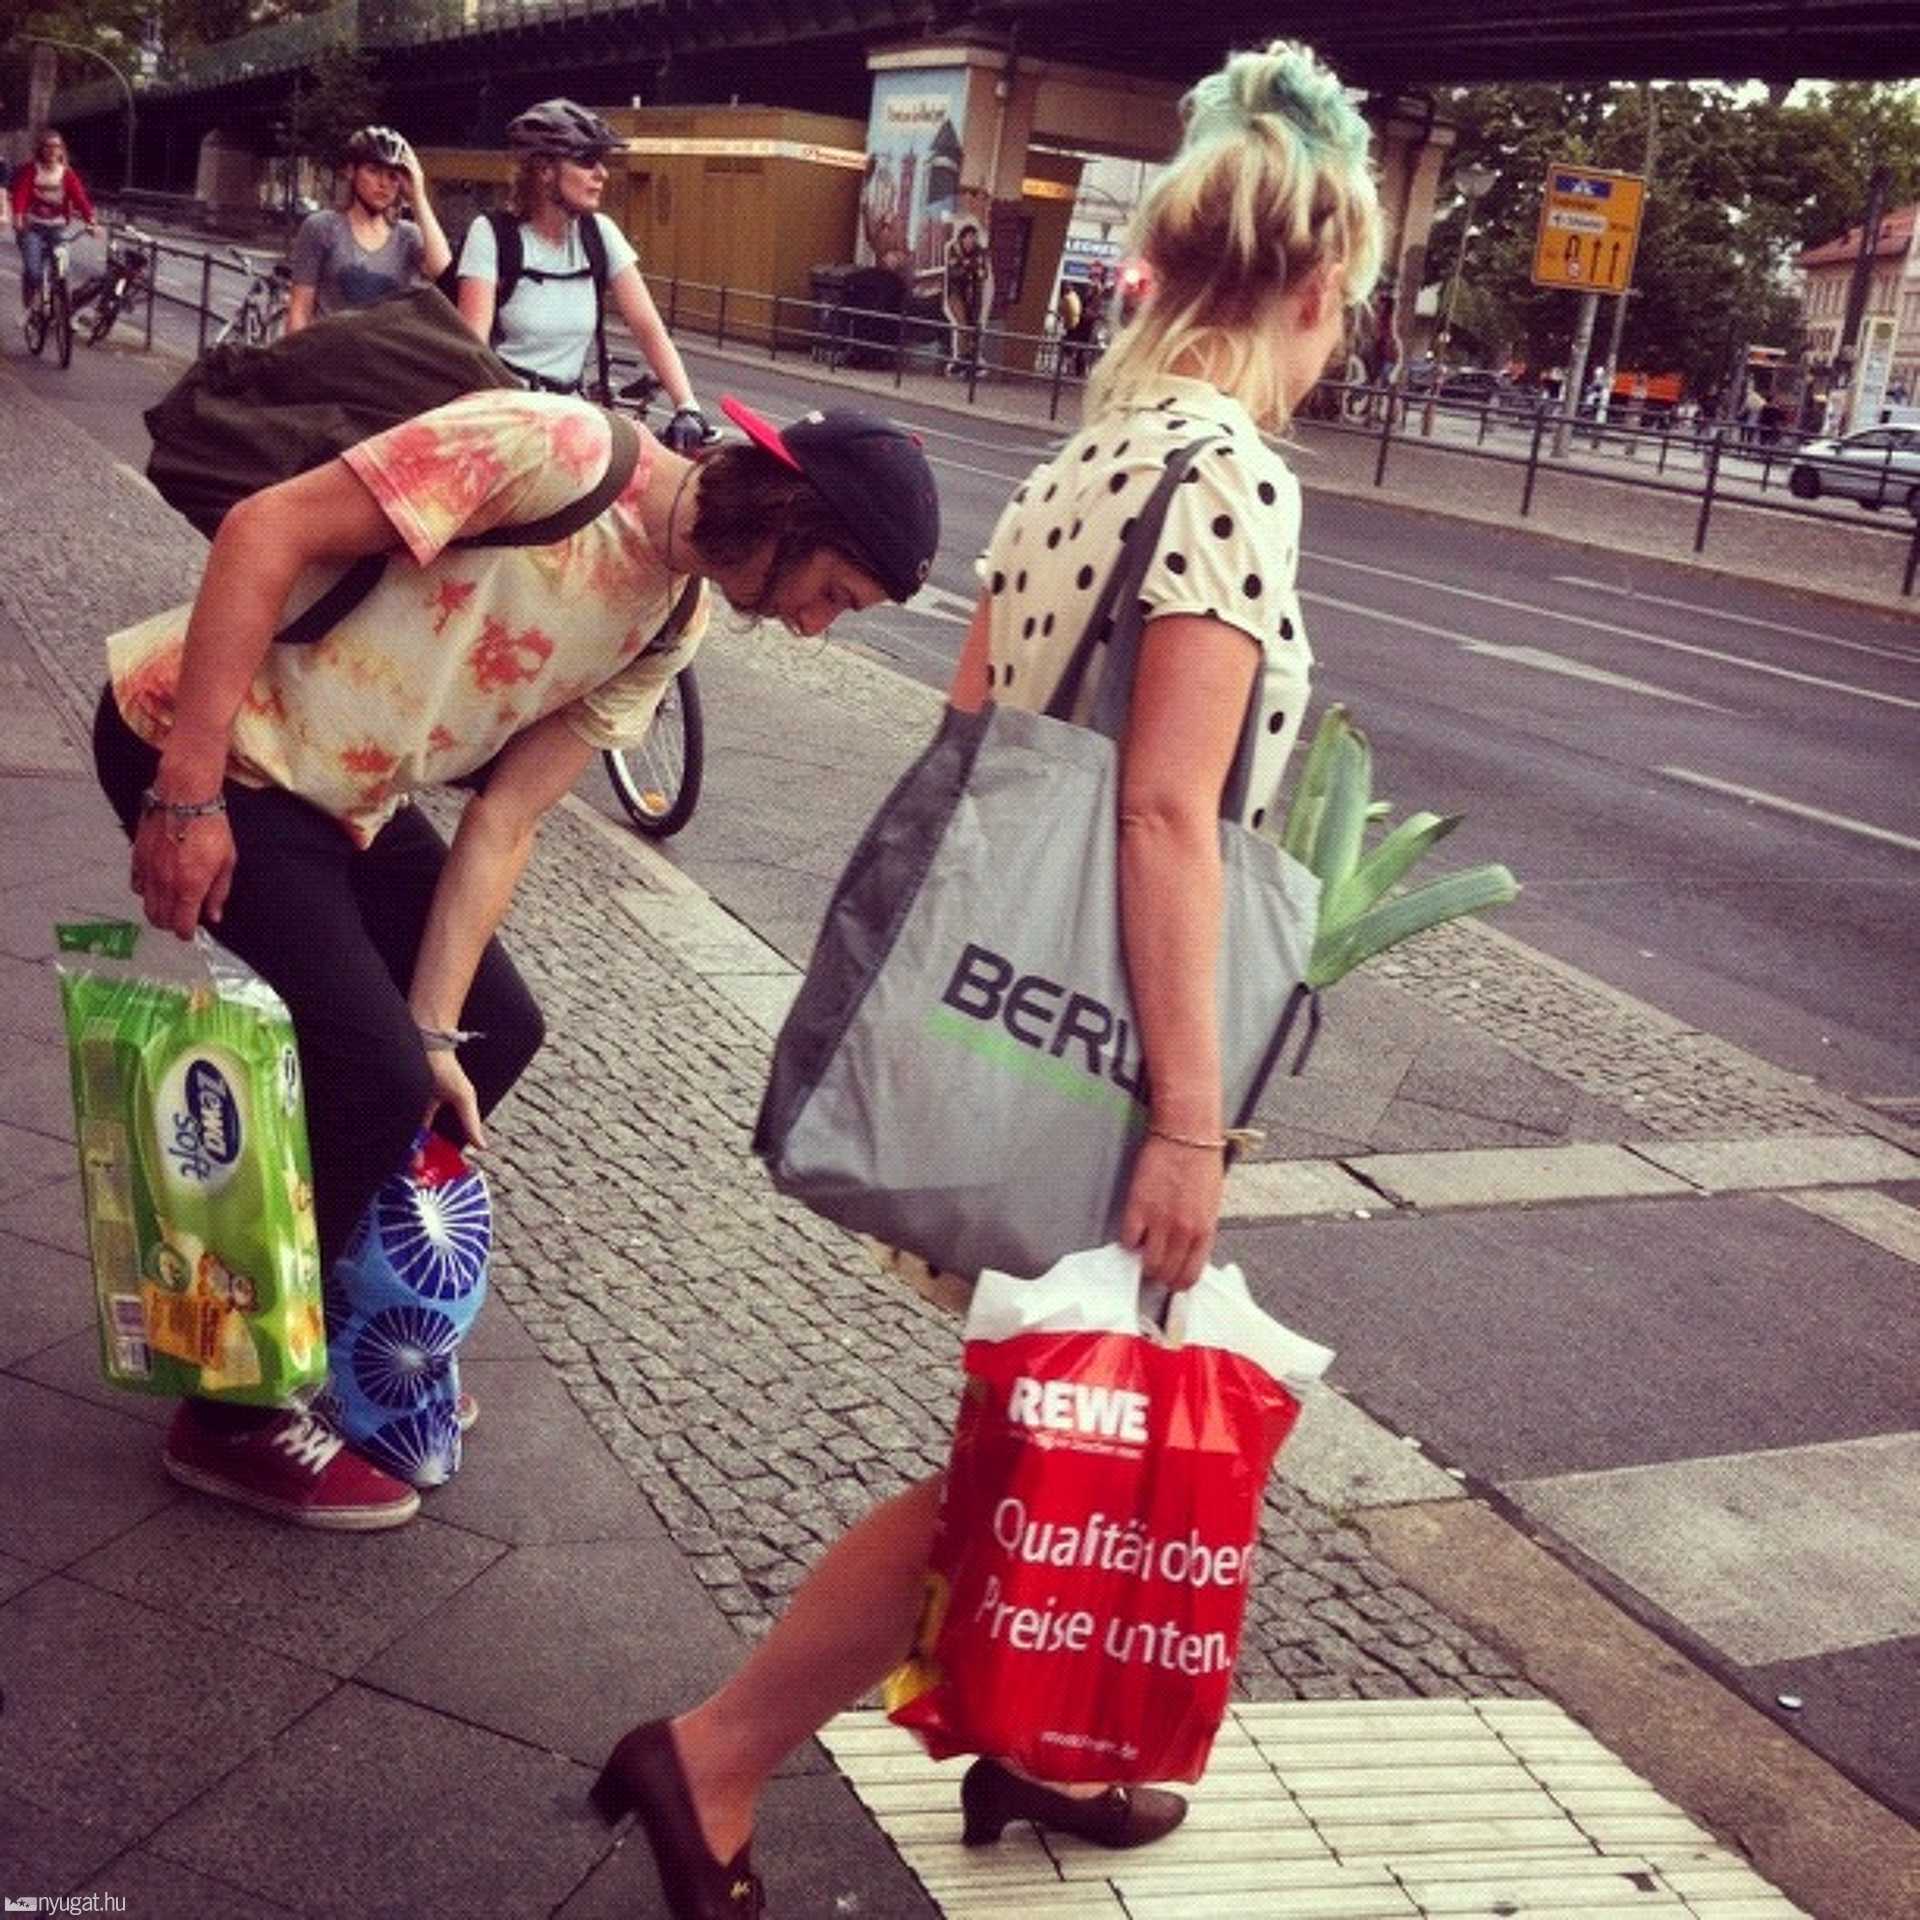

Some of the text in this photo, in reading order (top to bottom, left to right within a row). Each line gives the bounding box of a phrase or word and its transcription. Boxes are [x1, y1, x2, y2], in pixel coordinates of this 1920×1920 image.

[195, 1068, 228, 1160] Zewa
[1008, 1376, 1150, 1442] REWE
[975, 1574, 1232, 1676] Preise unten.
